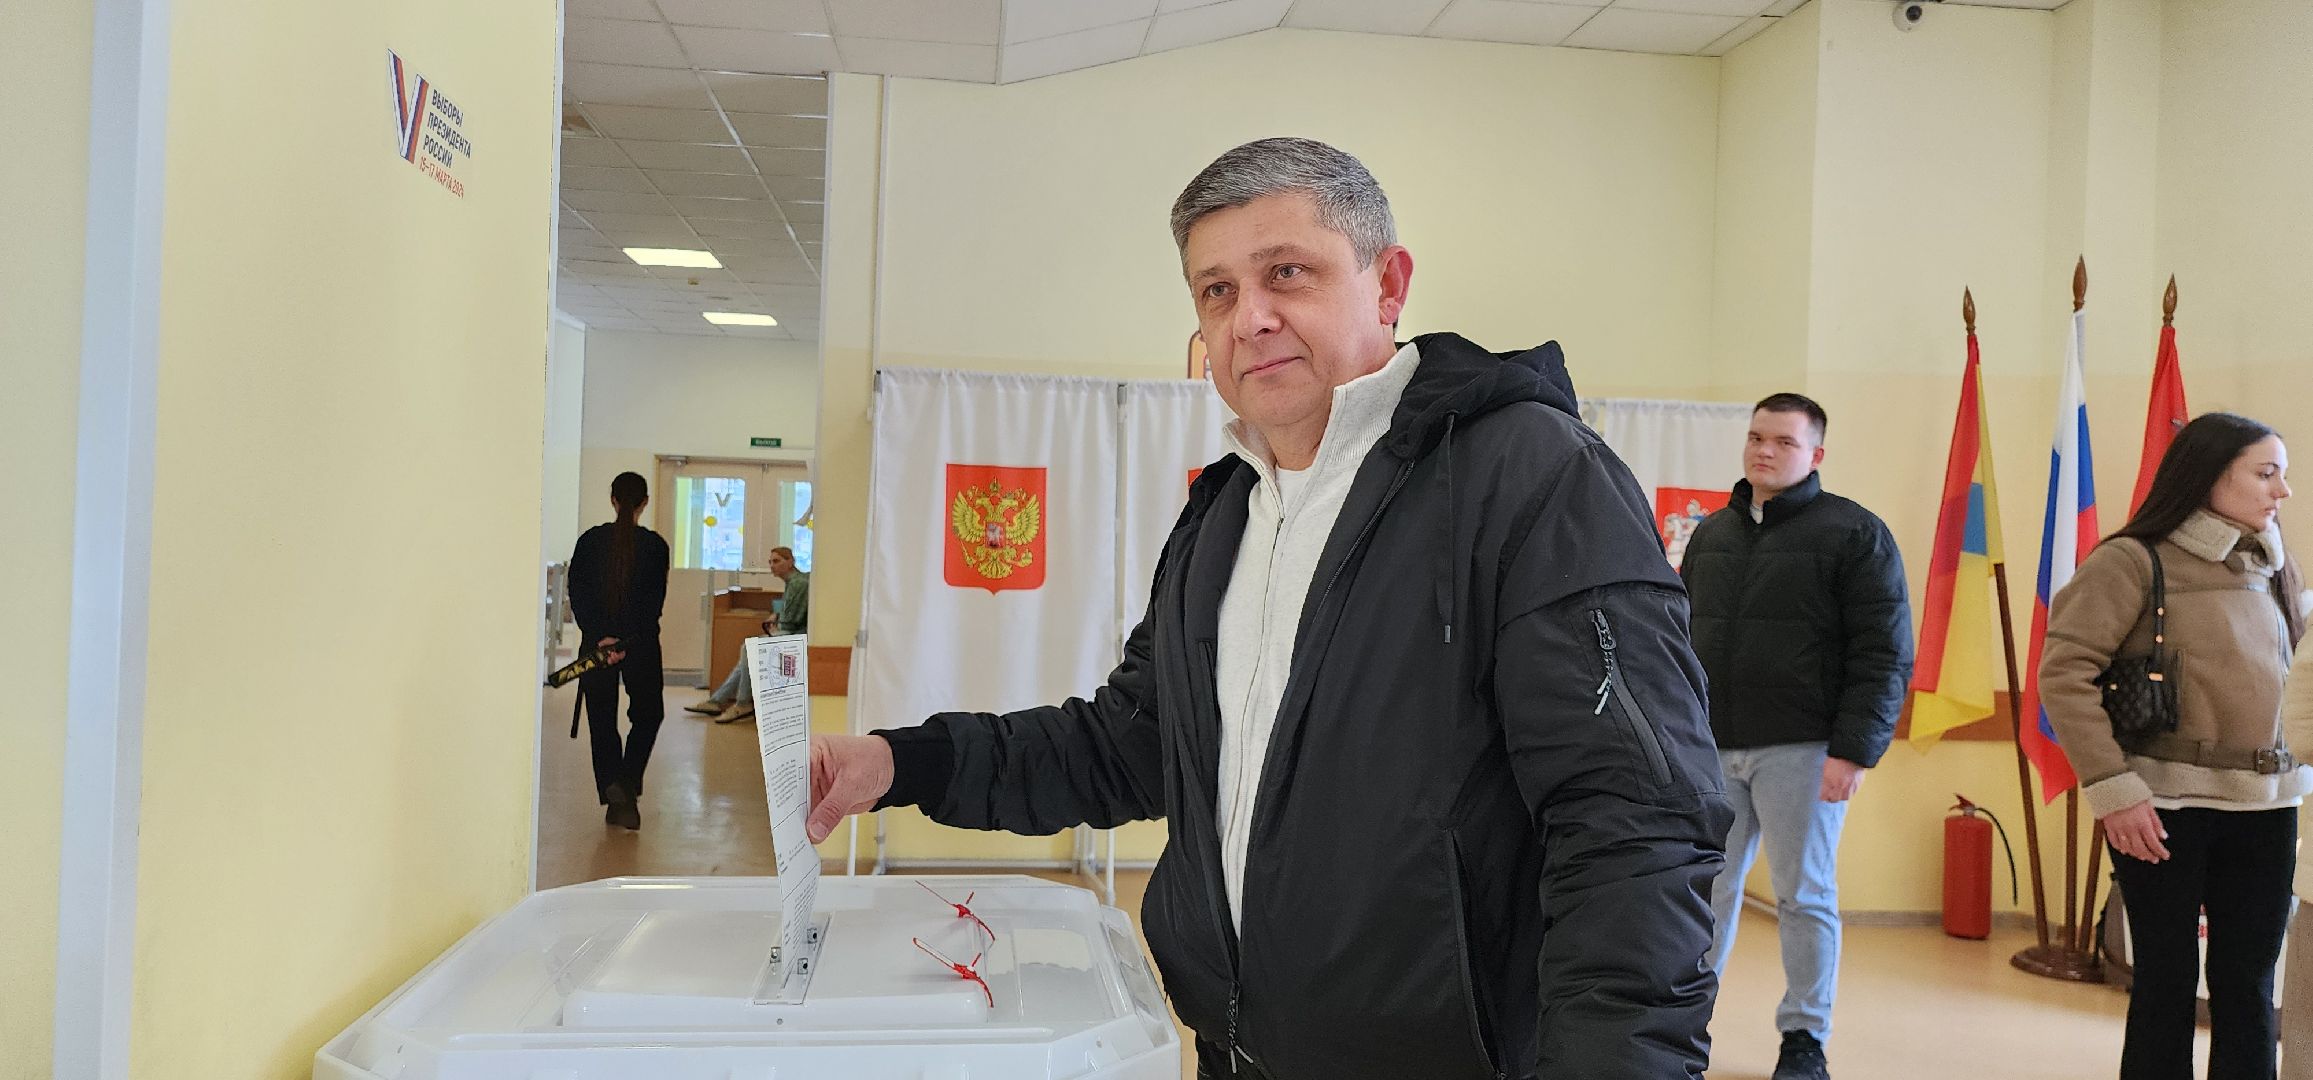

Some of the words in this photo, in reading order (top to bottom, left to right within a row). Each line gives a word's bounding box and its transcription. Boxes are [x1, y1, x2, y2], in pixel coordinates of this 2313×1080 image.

[431, 89, 464, 128] ВЫБОРЫ
[423, 134, 453, 168] РОССИИ
[427, 111, 472, 159] ПРЕЗИДЕНТА
[435, 168, 452, 191] МАРТА
